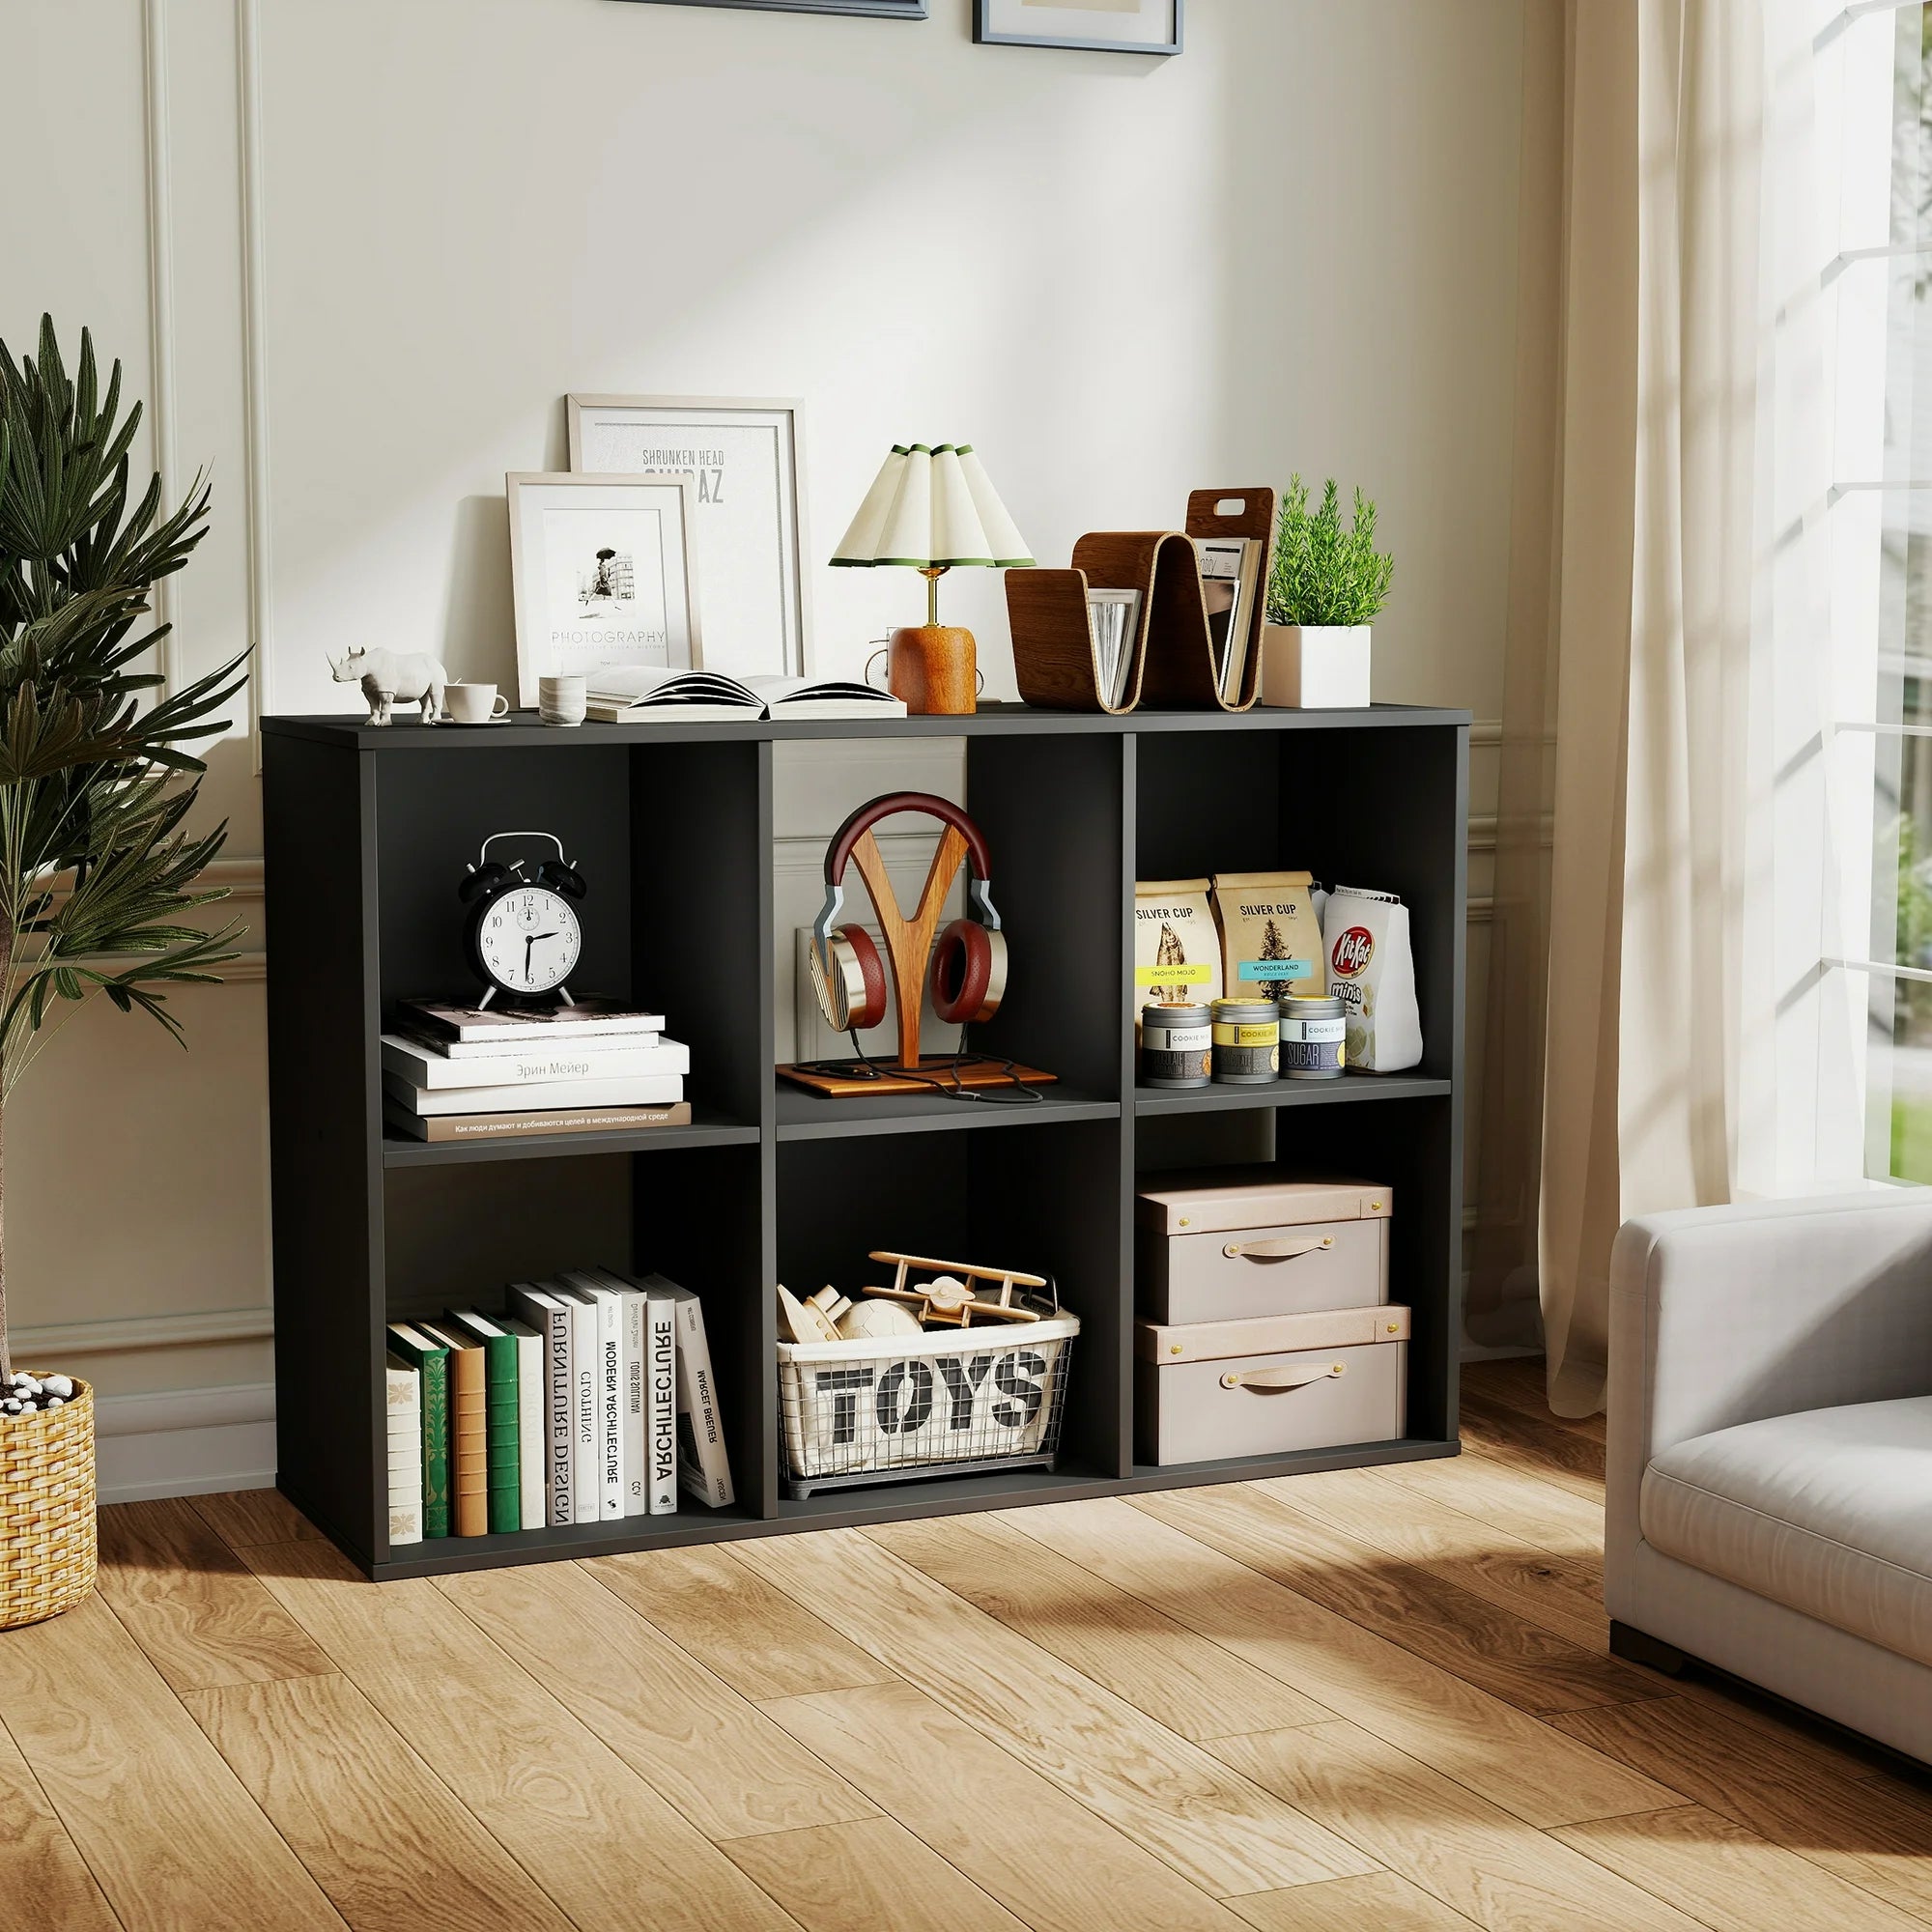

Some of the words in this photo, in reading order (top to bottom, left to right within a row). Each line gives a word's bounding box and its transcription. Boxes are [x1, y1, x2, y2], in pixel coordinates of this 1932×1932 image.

[642, 449, 696, 466] SHRUNKEN
[699, 450, 724, 466] HEAD
[552, 631, 665, 643] PHOTOGRAPHY
[506, 900, 515, 912] 11
[523, 895, 533, 906] 12
[1136, 908, 1171, 920] SILVER
[1173, 908, 1193, 918] CUP
[1239, 904, 1274, 916] SILVER
[1276, 904, 1296, 914] CUP
[493, 916, 502, 927] 10
[558, 912, 566, 923] 2
[485, 937, 493, 948] 9
[565, 932, 573, 943] 3
[492, 956, 500, 967] 8
[559, 952, 567, 962] 4
[508, 970, 514, 980] 7
[549, 967, 556, 978] 5
[527, 973, 534, 984] 6
[1331, 981, 1362, 1005] minis
[1288, 1043, 1320, 1065] SUGAR
[517, 1065, 546, 1078] Эрин
[550, 1062, 589, 1075] Мейер
[523, 1120, 563, 1129] добиваются
[565, 1118, 585, 1126] целей
[592, 1114, 647, 1123] международной
[815, 1351, 1047, 1443] TOYS
